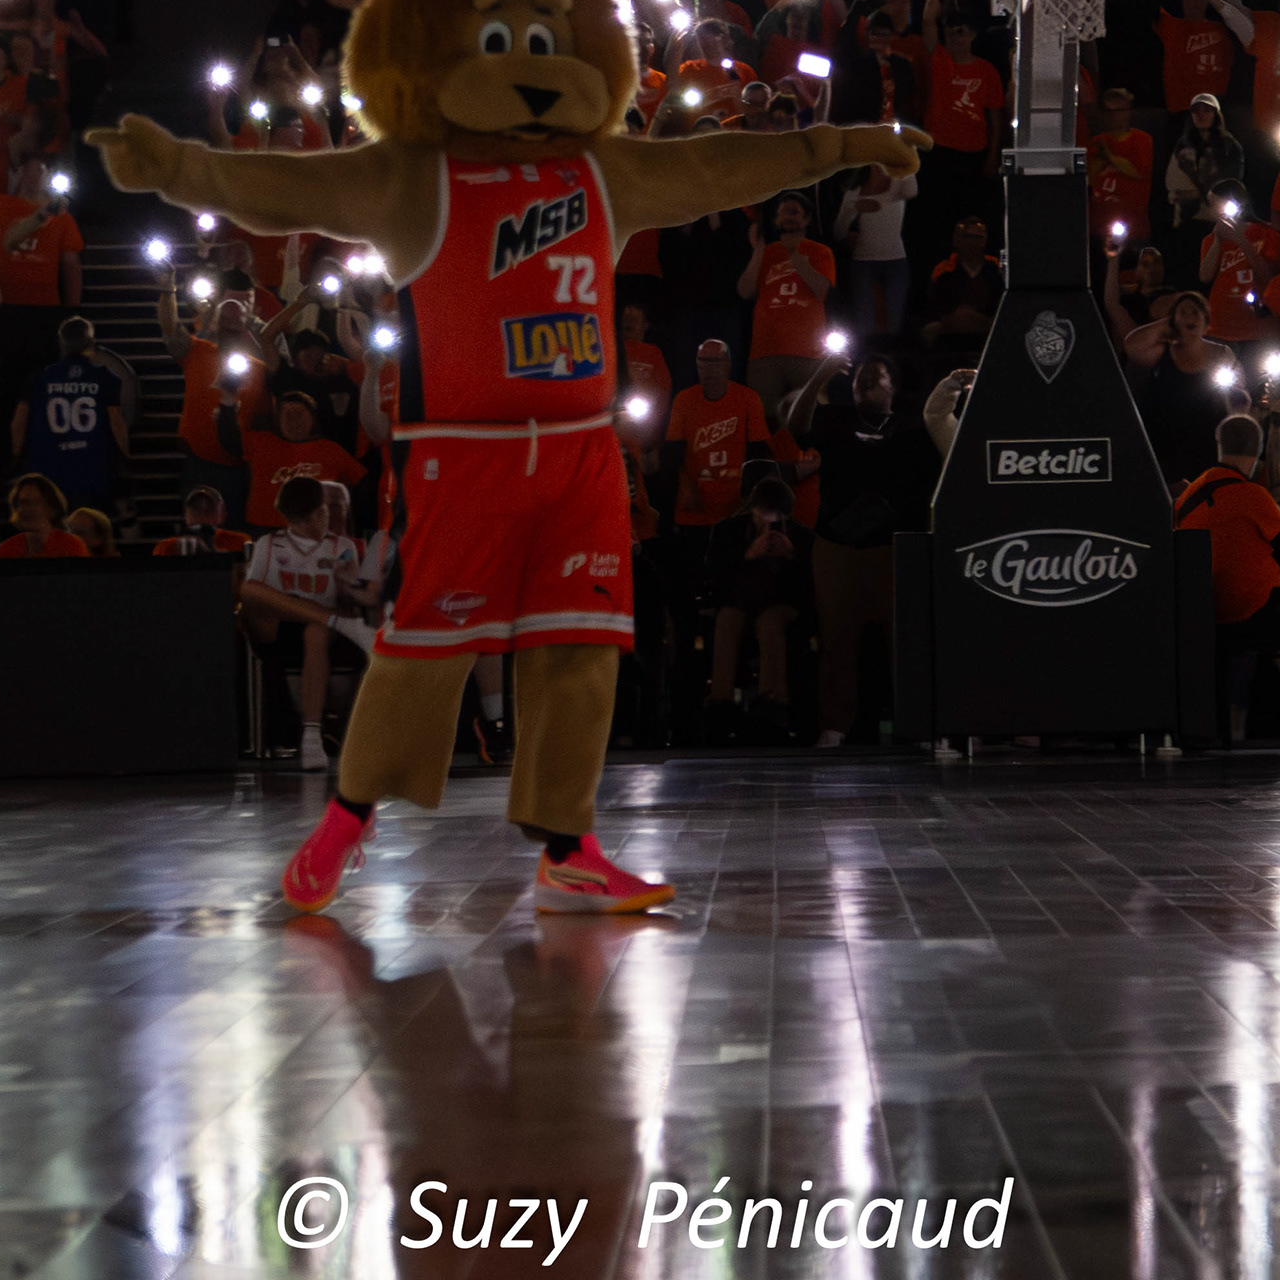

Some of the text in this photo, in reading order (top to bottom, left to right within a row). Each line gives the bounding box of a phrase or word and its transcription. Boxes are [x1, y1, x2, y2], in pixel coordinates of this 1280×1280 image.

[489, 187, 588, 278] MSB
[545, 254, 598, 305] 72
[46, 396, 97, 434] 06
[996, 446, 1103, 476] Betclic
[963, 538, 1139, 595] le Gaulois
